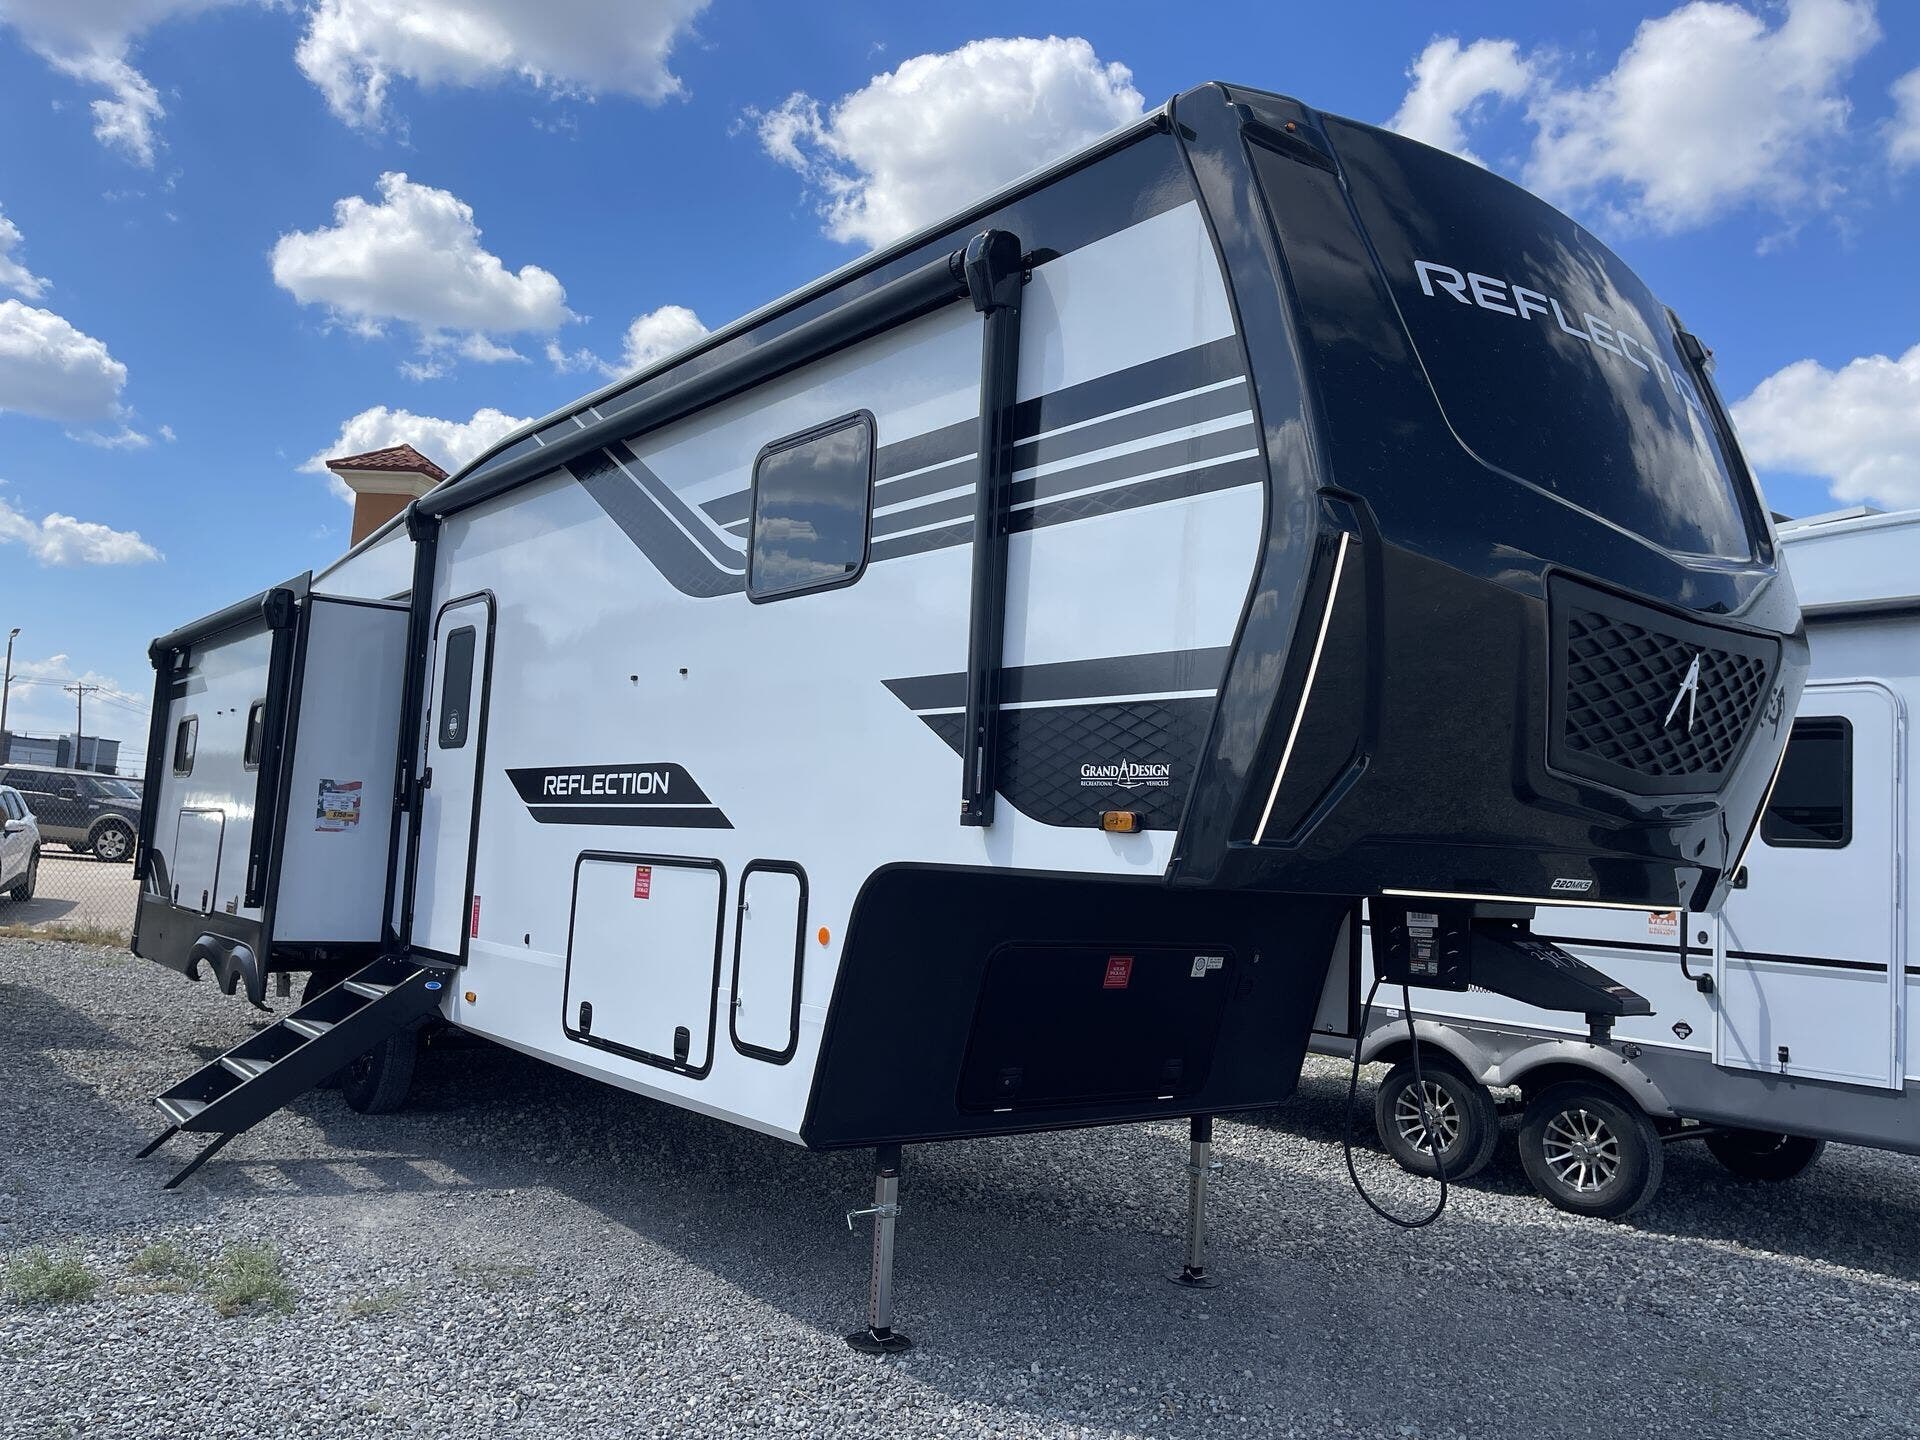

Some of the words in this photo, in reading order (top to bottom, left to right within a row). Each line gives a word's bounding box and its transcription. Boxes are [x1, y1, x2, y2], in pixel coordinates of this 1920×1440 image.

[1080, 763, 1119, 777] GRAND
[1129, 763, 1170, 777] DESIGN
[543, 771, 670, 796] REFLECTION
[1552, 880, 1590, 890] 320MKS
[1650, 918, 1676, 926] YEAR
